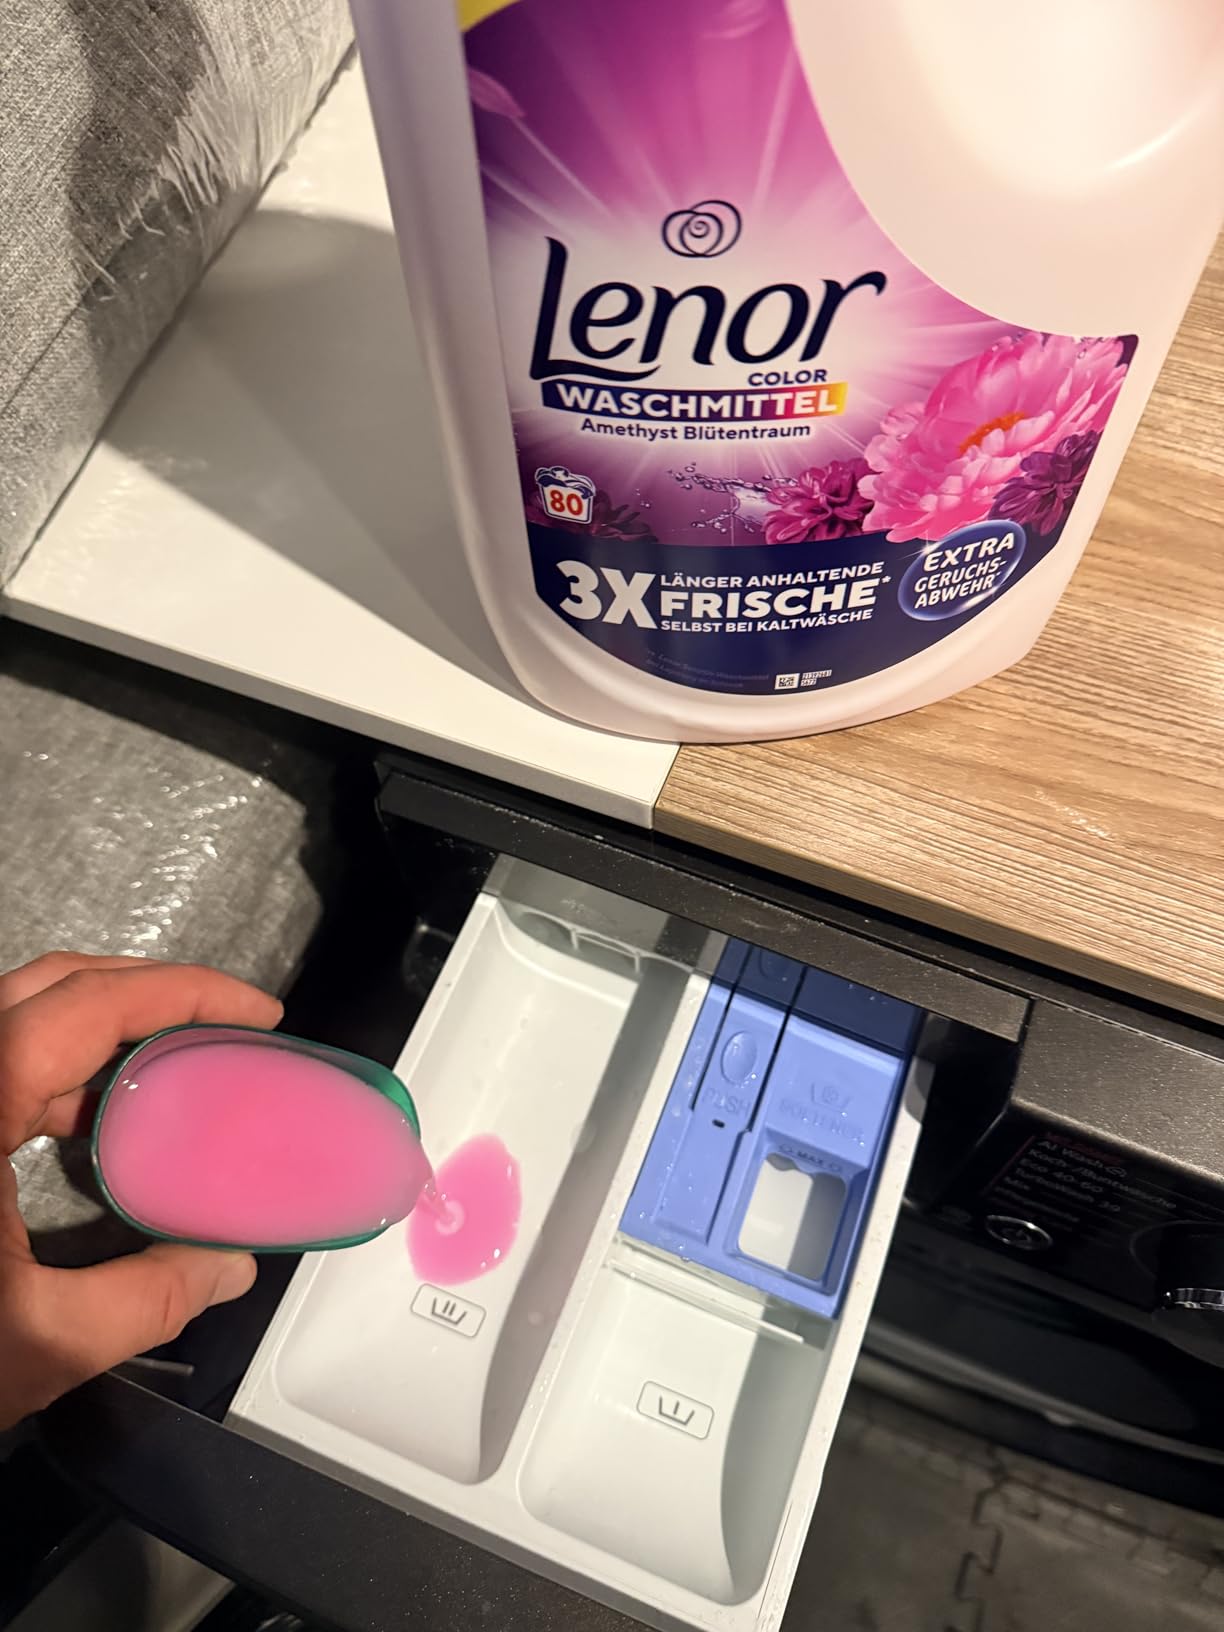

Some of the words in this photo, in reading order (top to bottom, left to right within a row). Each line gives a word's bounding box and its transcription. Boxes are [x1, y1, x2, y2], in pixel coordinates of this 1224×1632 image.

[529, 235, 888, 382] Lenor
[748, 369, 828, 387] COLOR
[556, 383, 837, 418] WASCHMITTEL
[581, 417, 678, 441] Amethyst
[684, 425, 810, 440] Blütentraum
[550, 489, 584, 517] 80
[923, 532, 1016, 573] EXTRA
[660, 572, 743, 589] LÄNGER
[746, 561, 885, 588] ANHALTENDE
[914, 556, 1007, 594] GERUCHS-
[556, 559, 658, 630] 3X
[661, 620, 722, 633] SELBST
[725, 622, 753, 633] BEI
[756, 608, 874, 632] KALTWÄSCHE
